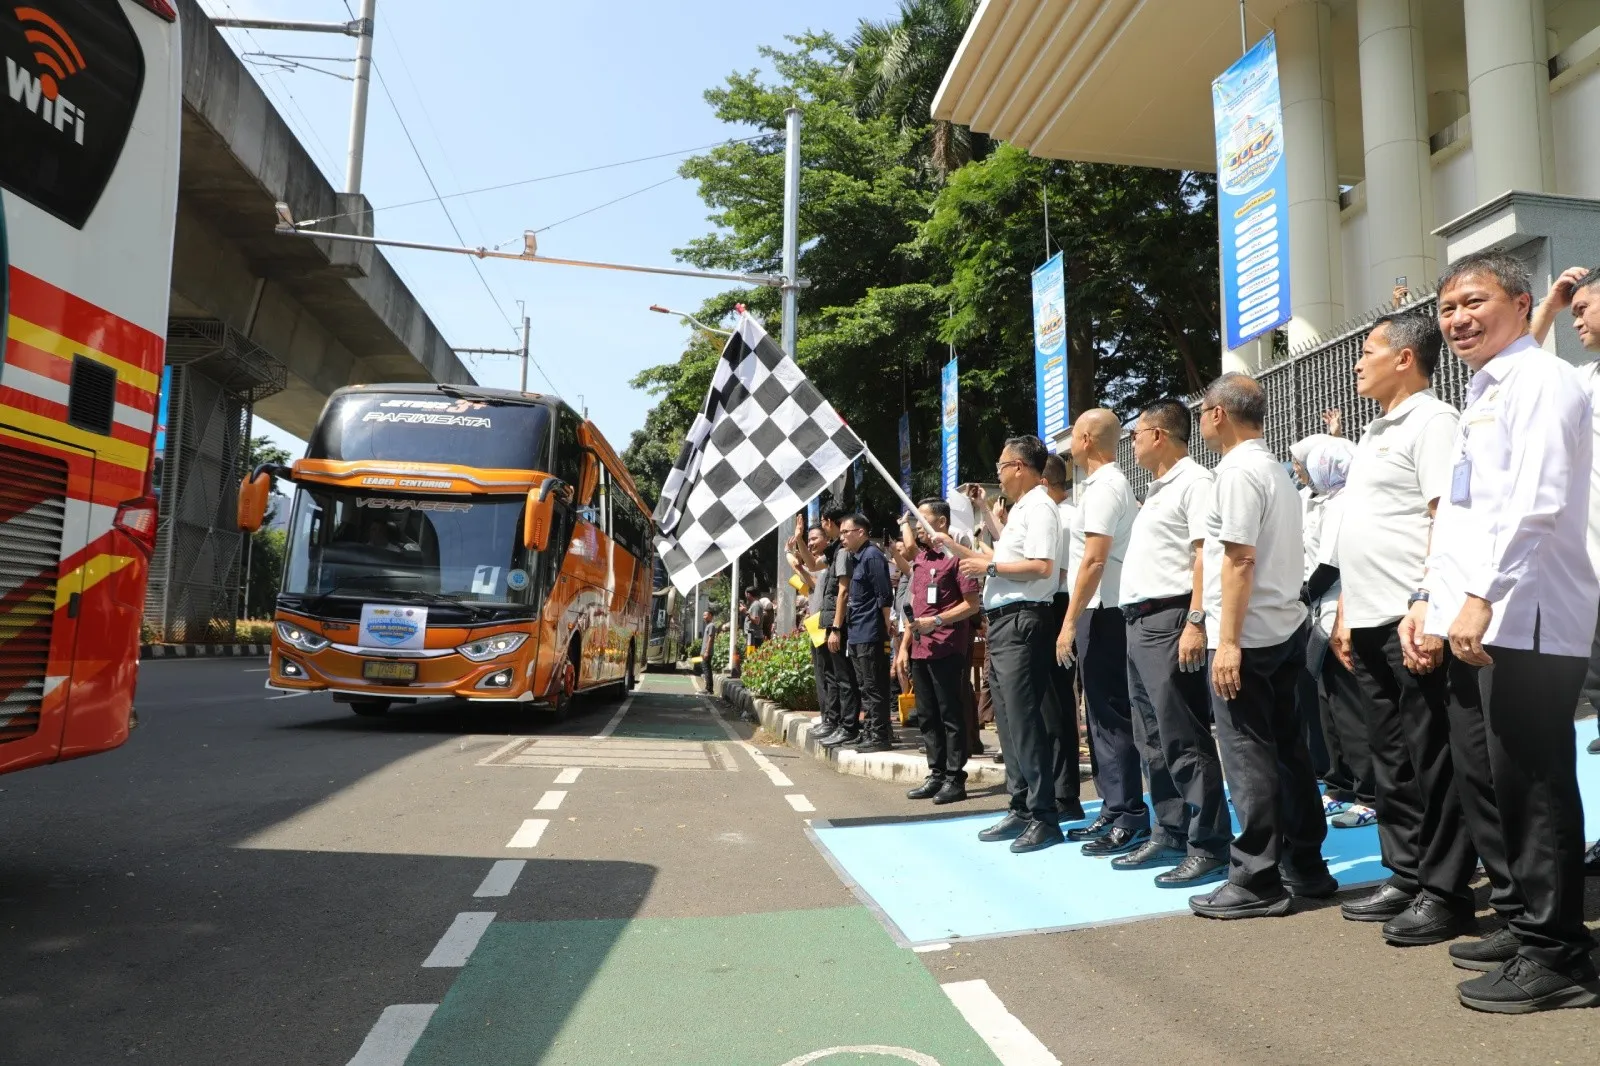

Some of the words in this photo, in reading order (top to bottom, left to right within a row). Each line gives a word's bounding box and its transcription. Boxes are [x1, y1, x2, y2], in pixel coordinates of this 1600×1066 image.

[5, 55, 86, 146] WiFi
[362, 412, 491, 428] PARIWISATA
[362, 477, 396, 486] LEADER
[398, 479, 452, 489] CENTURION
[355, 497, 474, 513] VOYAGER
[478, 566, 493, 586] 1
